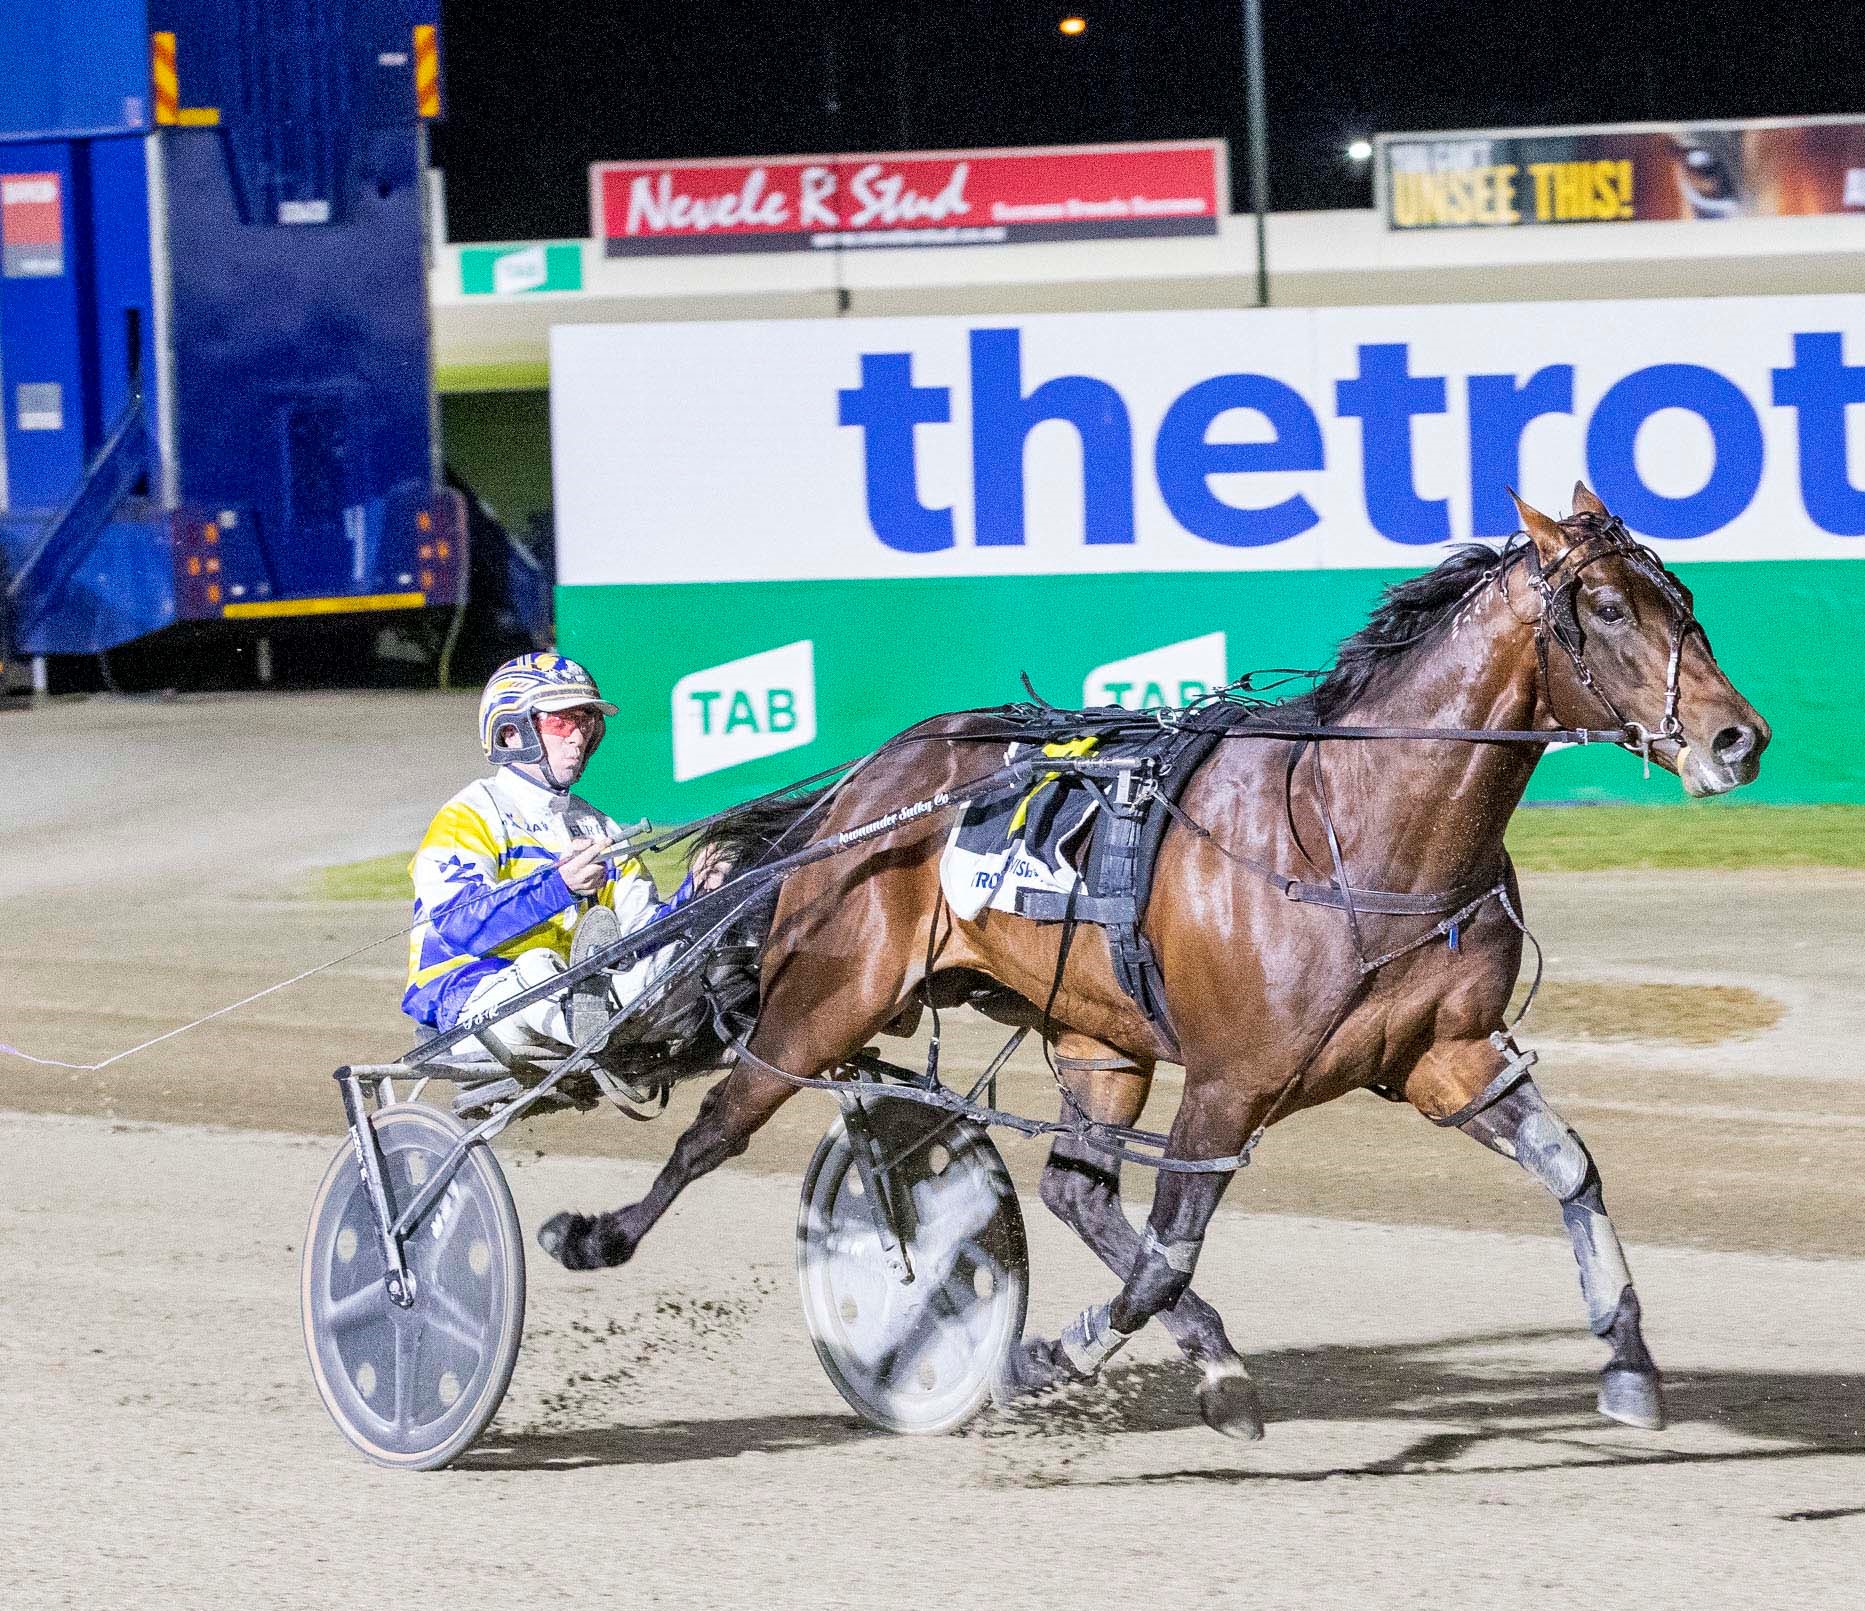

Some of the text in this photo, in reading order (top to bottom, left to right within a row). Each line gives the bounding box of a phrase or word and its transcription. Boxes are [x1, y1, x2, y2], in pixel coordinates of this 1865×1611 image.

[626, 160, 971, 235] Nevele R Stud
[1393, 159, 1633, 226] UNSEE THIS!
[689, 688, 798, 735] TAB
